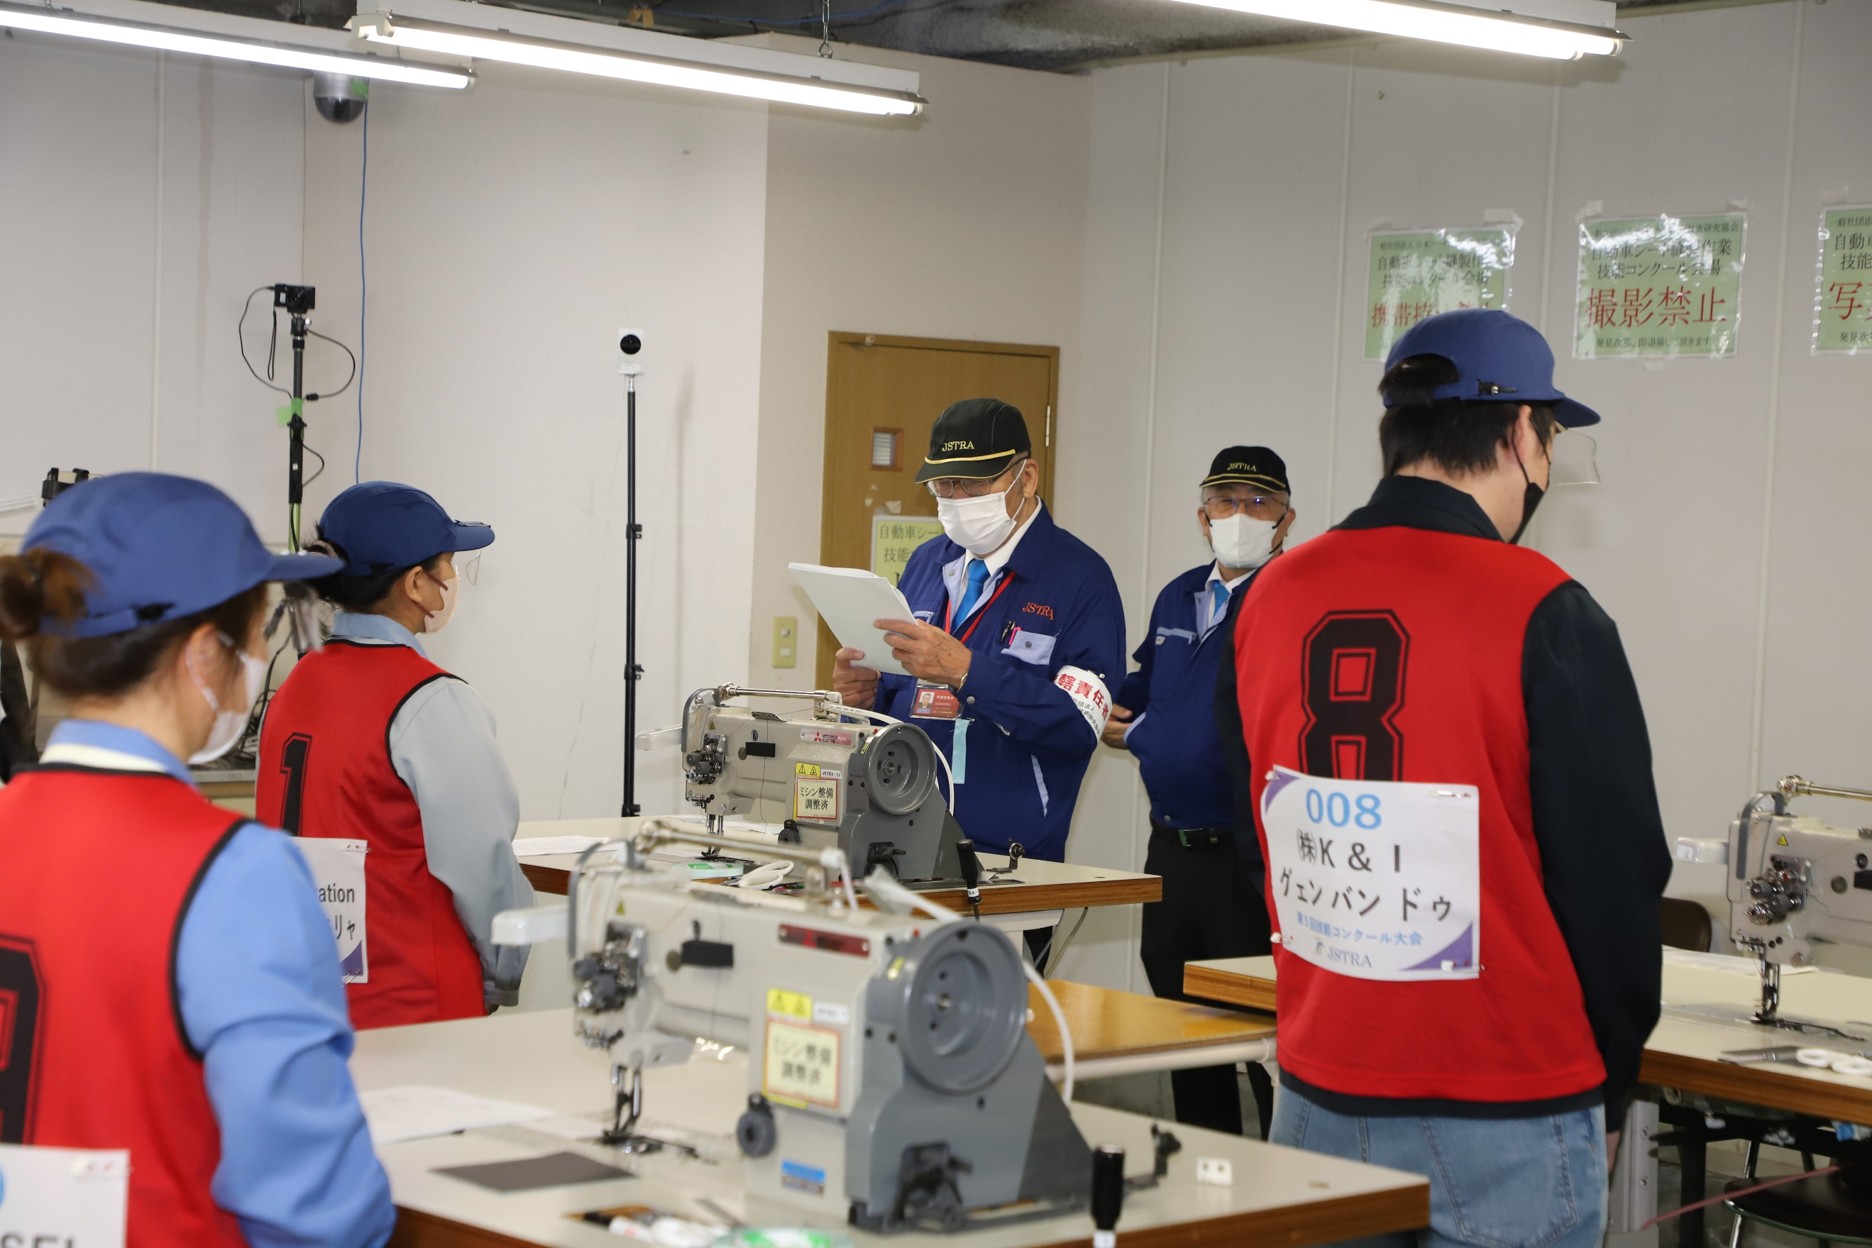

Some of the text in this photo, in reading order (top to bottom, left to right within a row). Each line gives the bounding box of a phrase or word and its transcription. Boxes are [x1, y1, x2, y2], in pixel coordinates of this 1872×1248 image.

[1585, 285, 1727, 329] 撮影禁止
[1827, 281, 1872, 321] 写
[941, 440, 976, 453] JSTRA
[1298, 609, 1411, 783] 8
[280, 731, 313, 838] 1
[800, 786, 834, 799] ミシン整備
[805, 798, 829, 811] 調整済
[1306, 788, 1382, 830] 008
[1348, 842, 1373, 873] &
[318, 883, 355, 904] ation
[1327, 945, 1373, 969] JSTRA
